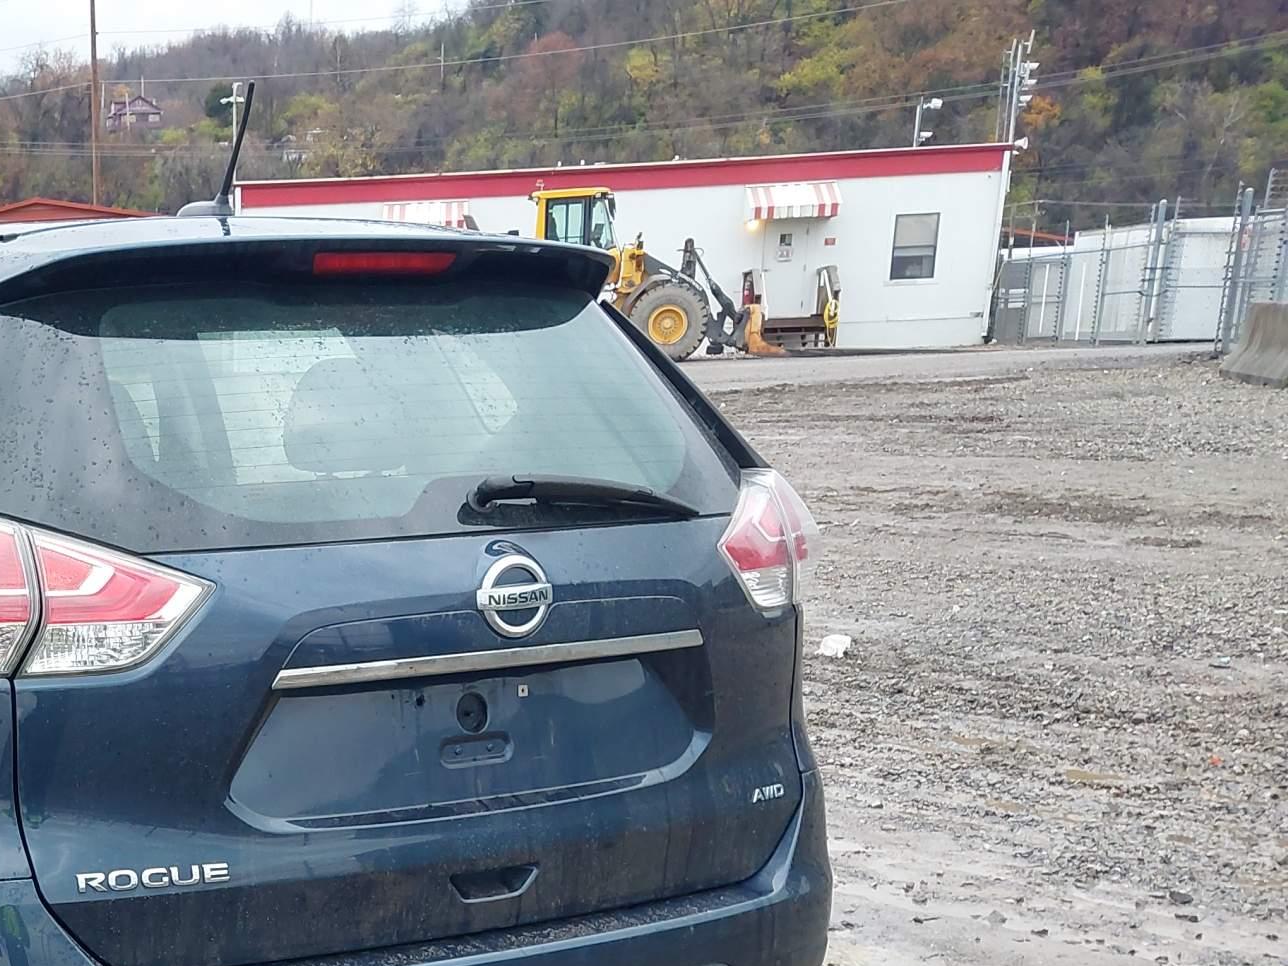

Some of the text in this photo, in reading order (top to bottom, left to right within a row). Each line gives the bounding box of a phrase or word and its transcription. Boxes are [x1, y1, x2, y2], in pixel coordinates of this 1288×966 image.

[487, 589, 549, 607] NISSAN
[752, 783, 785, 803] AWD
[75, 862, 231, 893] ROGUE
